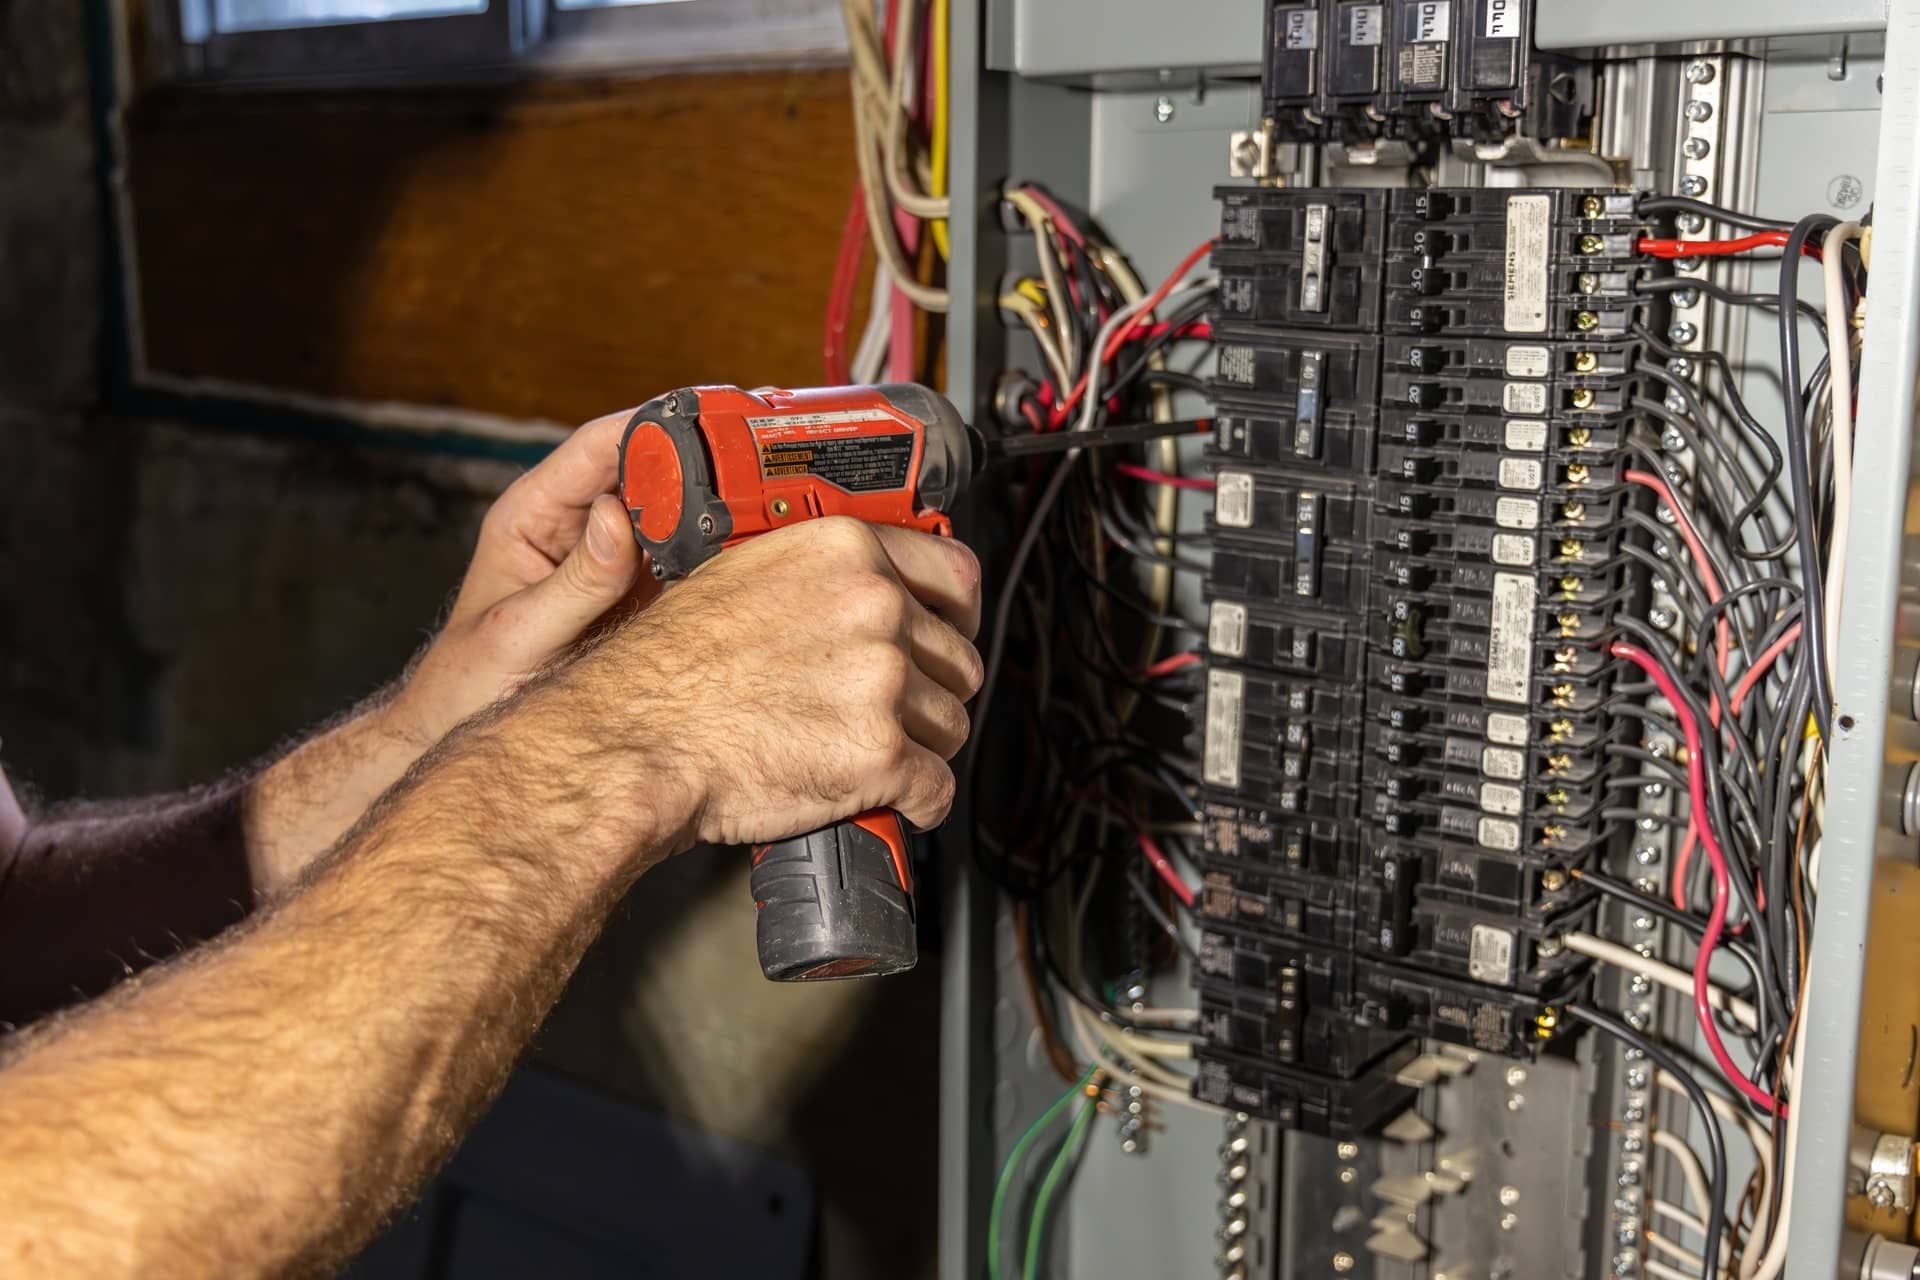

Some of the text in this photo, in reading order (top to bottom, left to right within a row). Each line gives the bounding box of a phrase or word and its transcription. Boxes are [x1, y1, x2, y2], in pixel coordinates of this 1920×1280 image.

[1356, 9, 1369, 41] OFF
[1423, 4, 1436, 39] OFF
[1492, 1, 1506, 35] OFF
[1416, 196, 1426, 214] 15
[1414, 232, 1425, 254] 30
[1411, 269, 1422, 291] 30
[1507, 251, 1516, 300] SIEMENS
[1410, 308, 1422, 327] 15
[1410, 350, 1422, 367] 20
[1408, 386, 1420, 404] 20
[1406, 423, 1417, 441] 15
[1403, 460, 1415, 478] 15
[1300, 504, 1311, 521] 15
[1400, 495, 1411, 513] 15
[1398, 532, 1409, 549] 15
[1397, 567, 1408, 585] 15
[1395, 601, 1408, 620] 30
[1293, 640, 1305, 658] 20
[1490, 627, 1500, 670] SIEMENS
[1391, 673, 1403, 692] 15
[1290, 692, 1304, 709] 15
[1390, 710, 1402, 728] 15
[1287, 725, 1302, 742] 25
[1388, 744, 1400, 762] 15
[1285, 758, 1298, 776] 25
[1387, 779, 1399, 796] 15
[1281, 792, 1296, 809] 15
[1386, 815, 1398, 832] 15
